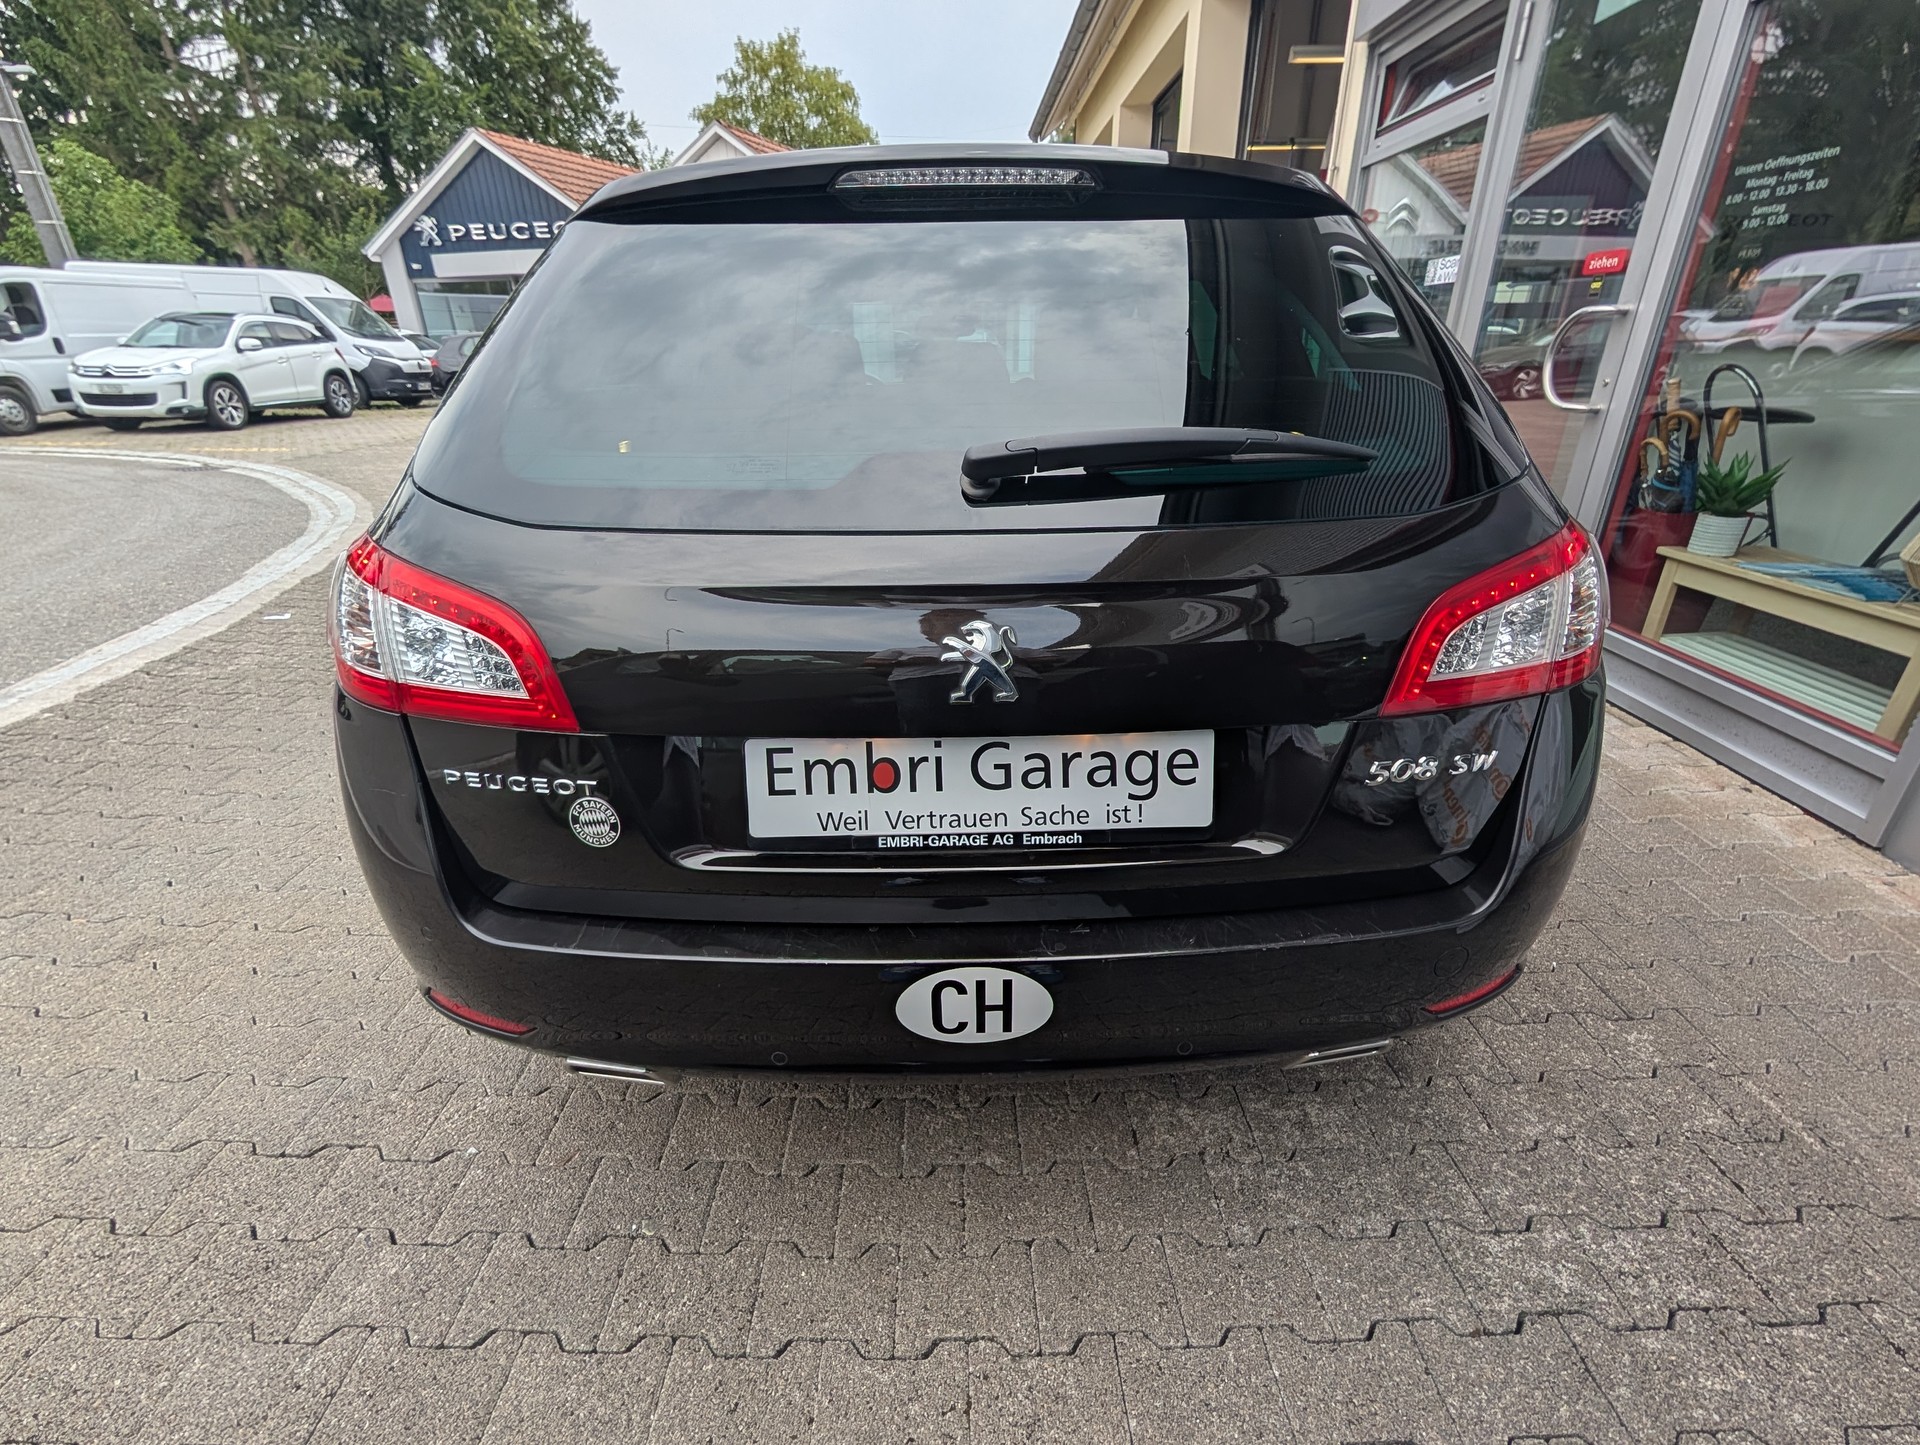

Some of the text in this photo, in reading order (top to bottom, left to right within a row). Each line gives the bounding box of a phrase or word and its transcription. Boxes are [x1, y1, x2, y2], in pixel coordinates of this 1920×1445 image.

[1735, 146, 1840, 176] Unsere Oeffnungszeiten
[1745, 175, 1778, 189] Montag
[1783, 168, 1815, 182] Freitag
[1749, 188, 1771, 201] 12.00
[1805, 178, 1829, 192] 18.00
[1751, 203, 1787, 216] Samstag
[1742, 217, 1760, 230] 9.00
[1440, 258, 1461, 270] Sca
[1589, 256, 1618, 270] ziehen
[765, 740, 1199, 801] Embri Garage
[1364, 750, 1498, 787] 508 SW
[444, 769, 598, 796] PEUGEOT
[573, 801, 617, 823] FC BAYERN
[817, 810, 869, 832] Weil
[885, 810, 1008, 831] Vertrauen
[1021, 804, 1090, 827] Sache
[878, 832, 1082, 848] EMBRI-GARAGE AG Embrach
[931, 979, 1013, 1034] CH
